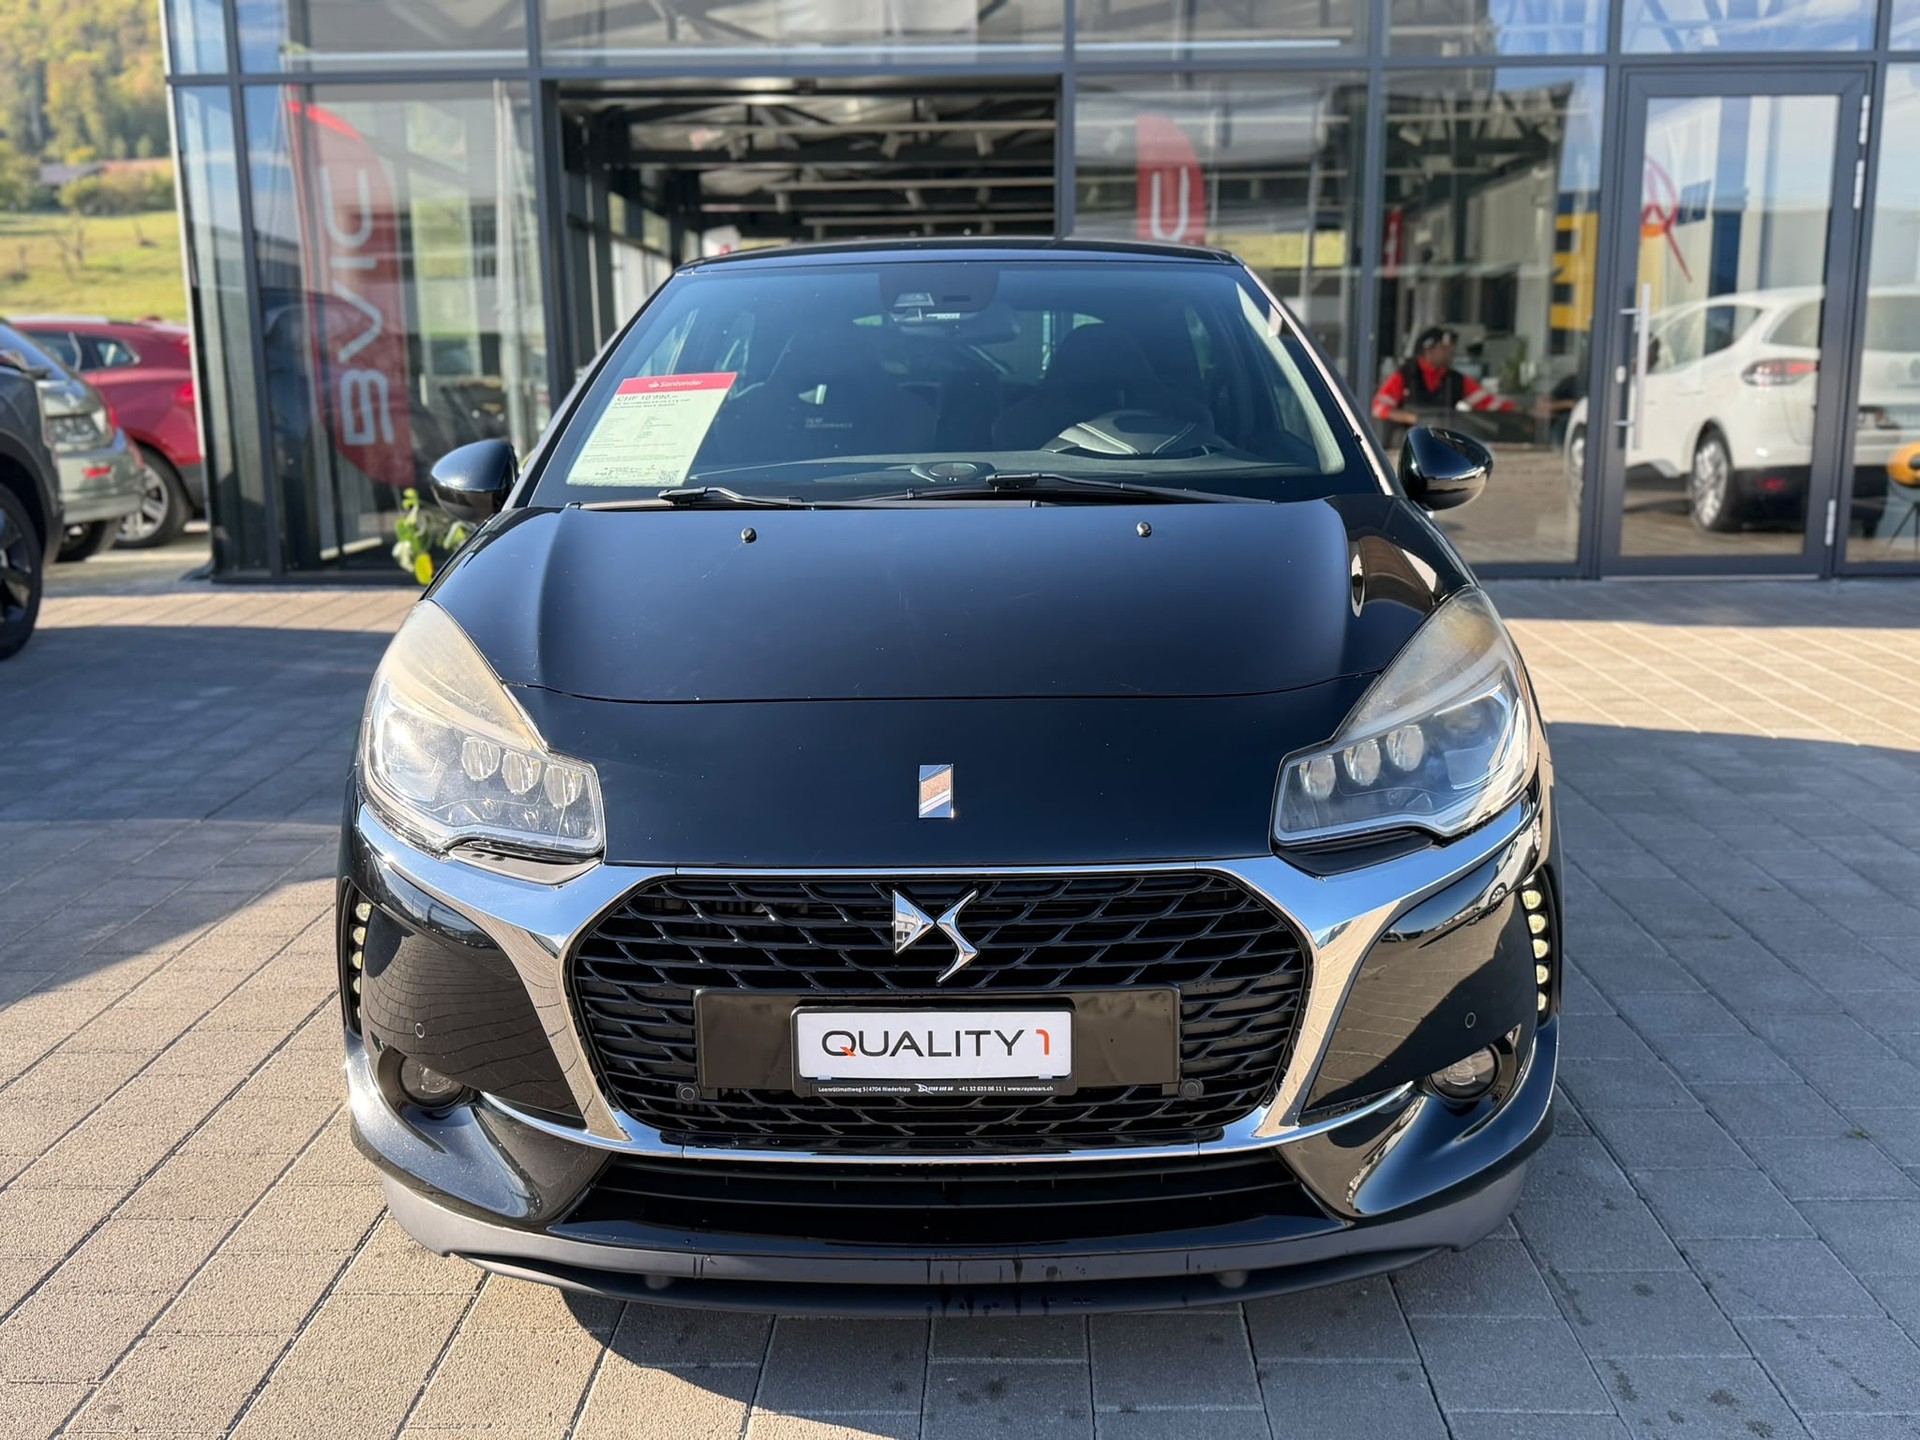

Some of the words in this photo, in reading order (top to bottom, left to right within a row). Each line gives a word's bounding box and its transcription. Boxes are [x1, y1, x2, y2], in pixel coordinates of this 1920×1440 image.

[658, 379, 703, 388] Santander
[821, 1029, 1025, 1057] QUALITY
[1035, 1028, 1051, 1056] 1
